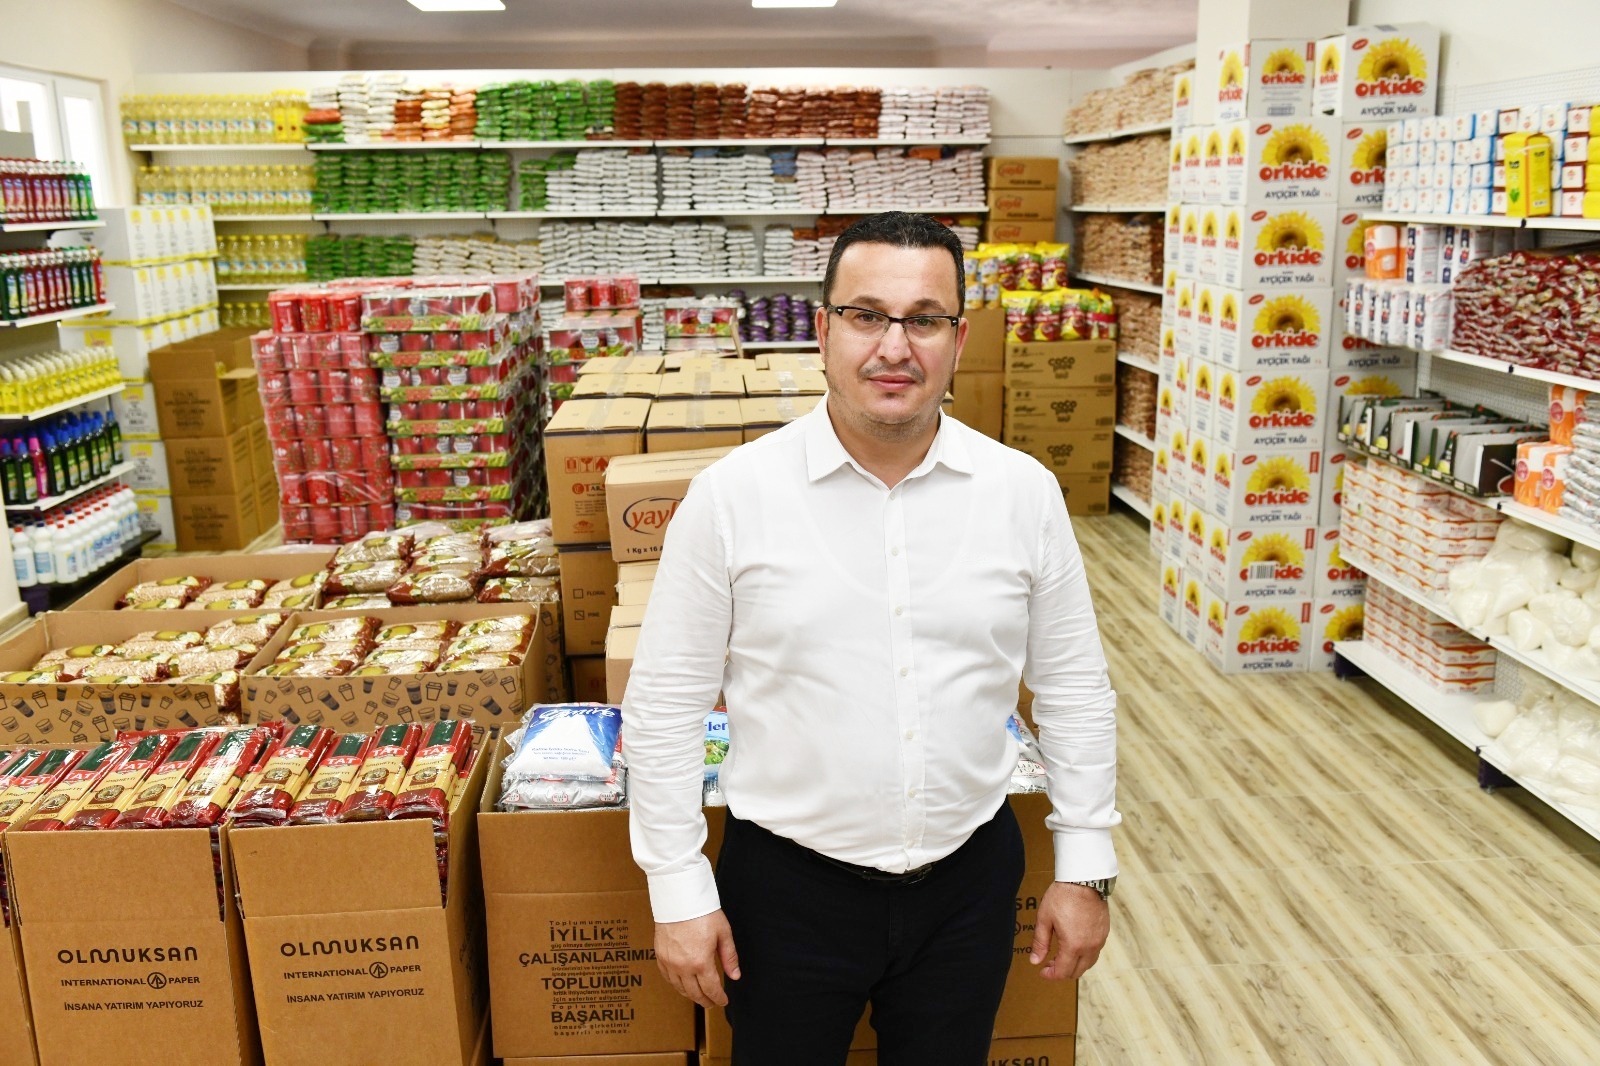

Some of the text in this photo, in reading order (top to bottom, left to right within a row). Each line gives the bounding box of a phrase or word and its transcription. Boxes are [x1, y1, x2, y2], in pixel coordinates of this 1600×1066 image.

[1261, 71, 1306, 85] orkide
[1355, 75, 1425, 97] orkide
[1259, 160, 1327, 181] orkide
[1350, 166, 1385, 184] ork
[1254, 246, 1322, 267] orkide
[1251, 329, 1318, 349] orkide
[1249, 410, 1315, 428] orkide
[1244, 487, 1310, 506] orkide
[630, 501, 678, 531] yayl
[1237, 638, 1300, 655] orkide
[278, 748, 307, 757] TAT
[372, 747, 400, 757] TAT
[118, 762, 147, 770] TAT
[158, 762, 187, 771] TAT
[327, 757, 356, 765] TAT
[550, 926, 615, 942] İYİLİK
[280, 935, 419, 957] OLMUKSAN
[57, 946, 198, 964] OLMUKSAN
[284, 964, 421, 980] INTERNATIONAL PAPER
[61, 976, 201, 987] INTERNATIONAL PAPER
[541, 975, 643, 990] TOPLUMUN
[286, 988, 424, 1003] İNSANA YATIRIM YAPIYORUZ
[64, 1000, 204, 1011] İNSANA YATIRIM YAPIYORUZ
[551, 1008, 635, 1025] BAŞARILI
